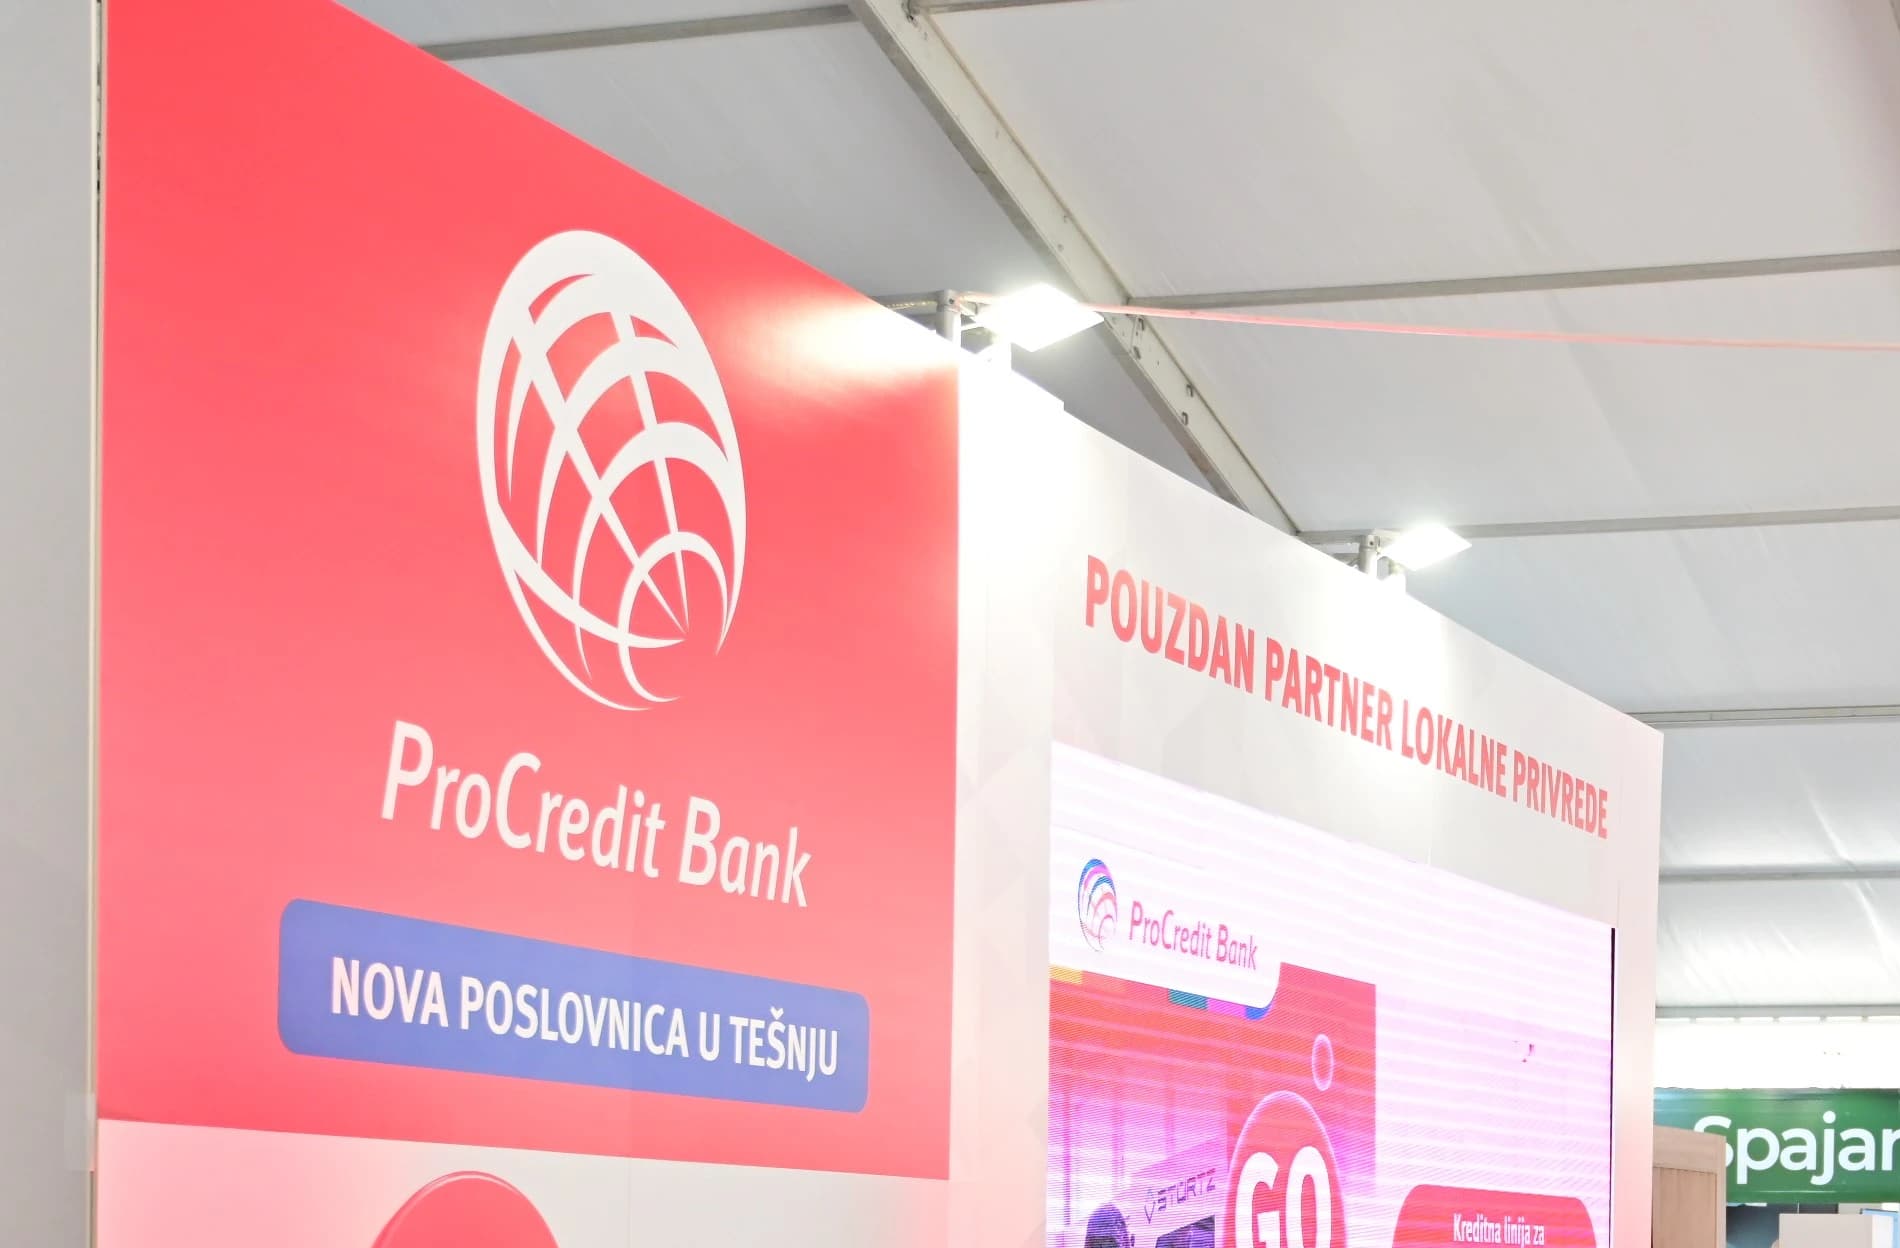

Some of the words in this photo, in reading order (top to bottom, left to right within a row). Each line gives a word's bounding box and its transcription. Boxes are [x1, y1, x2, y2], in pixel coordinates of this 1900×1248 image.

[1085, 555, 1255, 693] POUZDAN
[1264, 637, 1393, 749] PARTNER
[1401, 700, 1507, 798] LOKALNE
[1513, 750, 1608, 839] PRIVREDE
[381, 720, 666, 877] ProCredit
[679, 796, 812, 907] Bank
[1129, 901, 1211, 962] ProCredit
[1217, 924, 1258, 971] Bank
[331, 957, 448, 1028] NOVA
[460, 976, 690, 1059] POSLOVNICA
[699, 1010, 721, 1061] U
[730, 1006, 838, 1082] TEŠNJU
[1453, 1213, 1502, 1243] Kreditna
[1533, 1224, 1545, 1246] za
